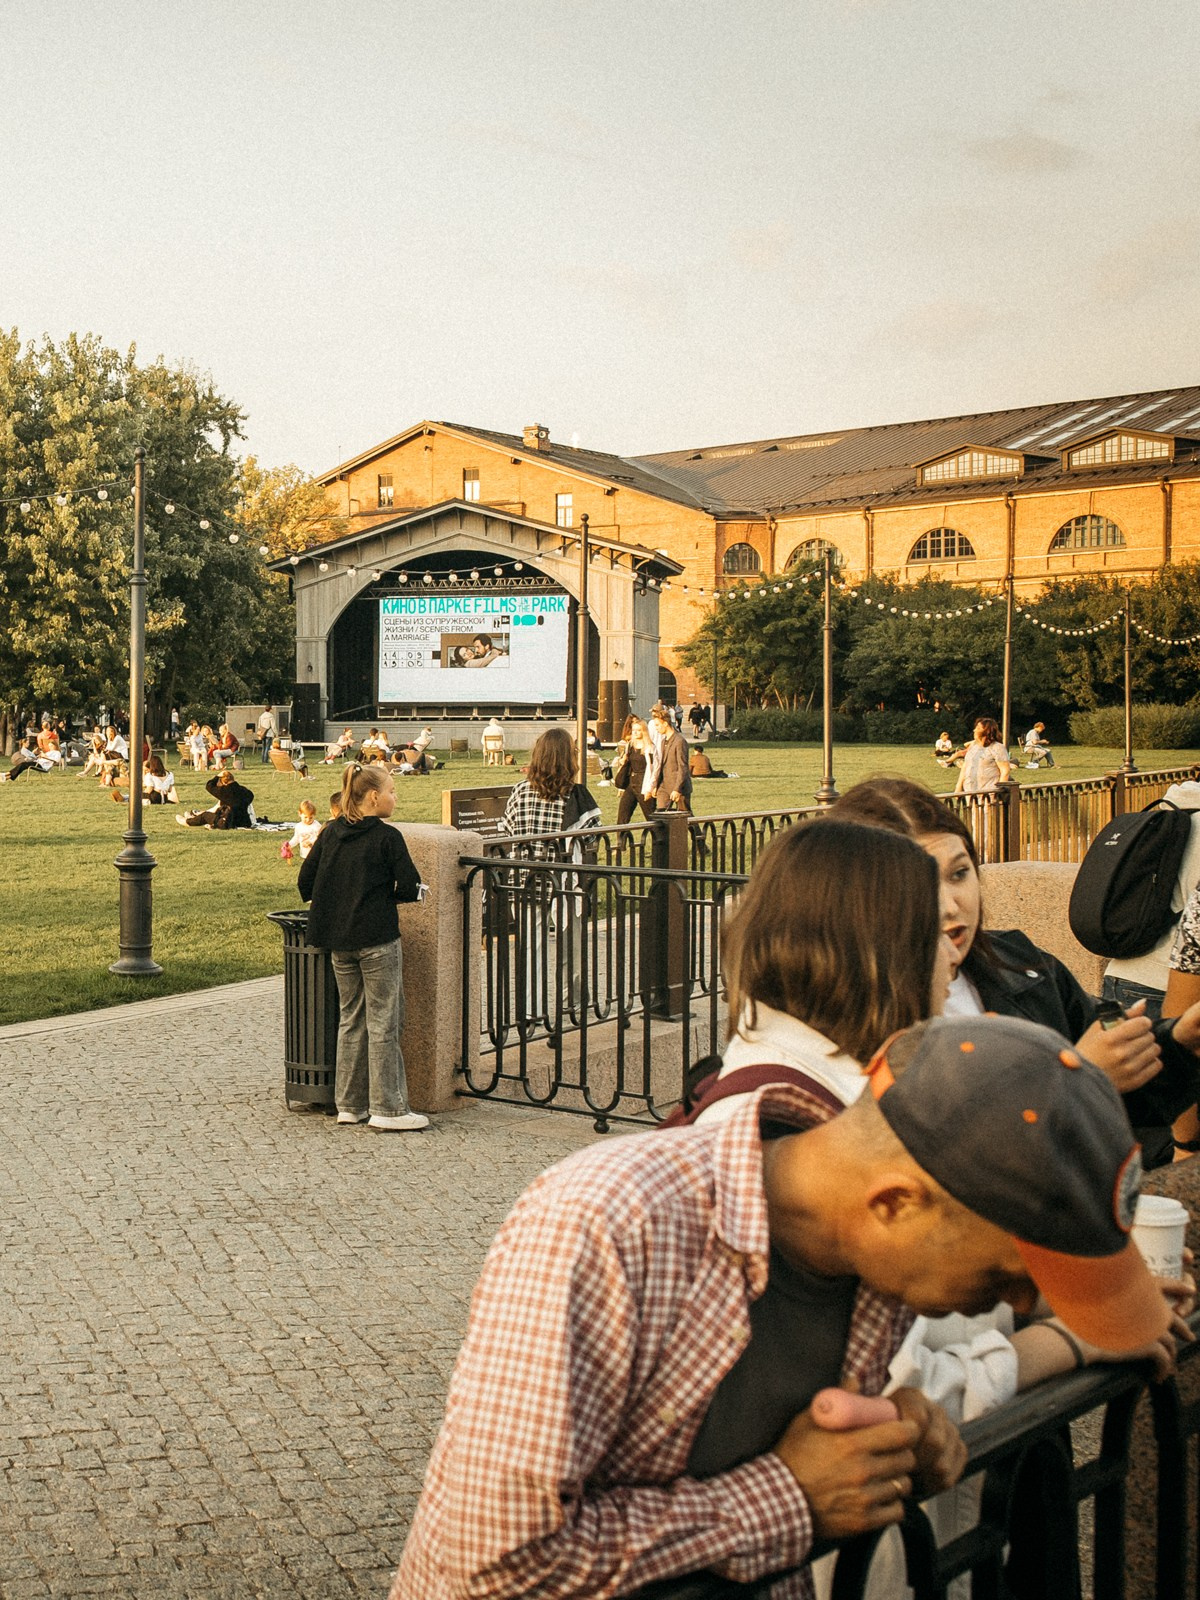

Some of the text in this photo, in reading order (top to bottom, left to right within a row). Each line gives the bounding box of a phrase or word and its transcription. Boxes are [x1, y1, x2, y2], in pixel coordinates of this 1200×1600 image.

[382, 596, 566, 614] КИНО В ПАРКЕ FILMS IN THE PARK
